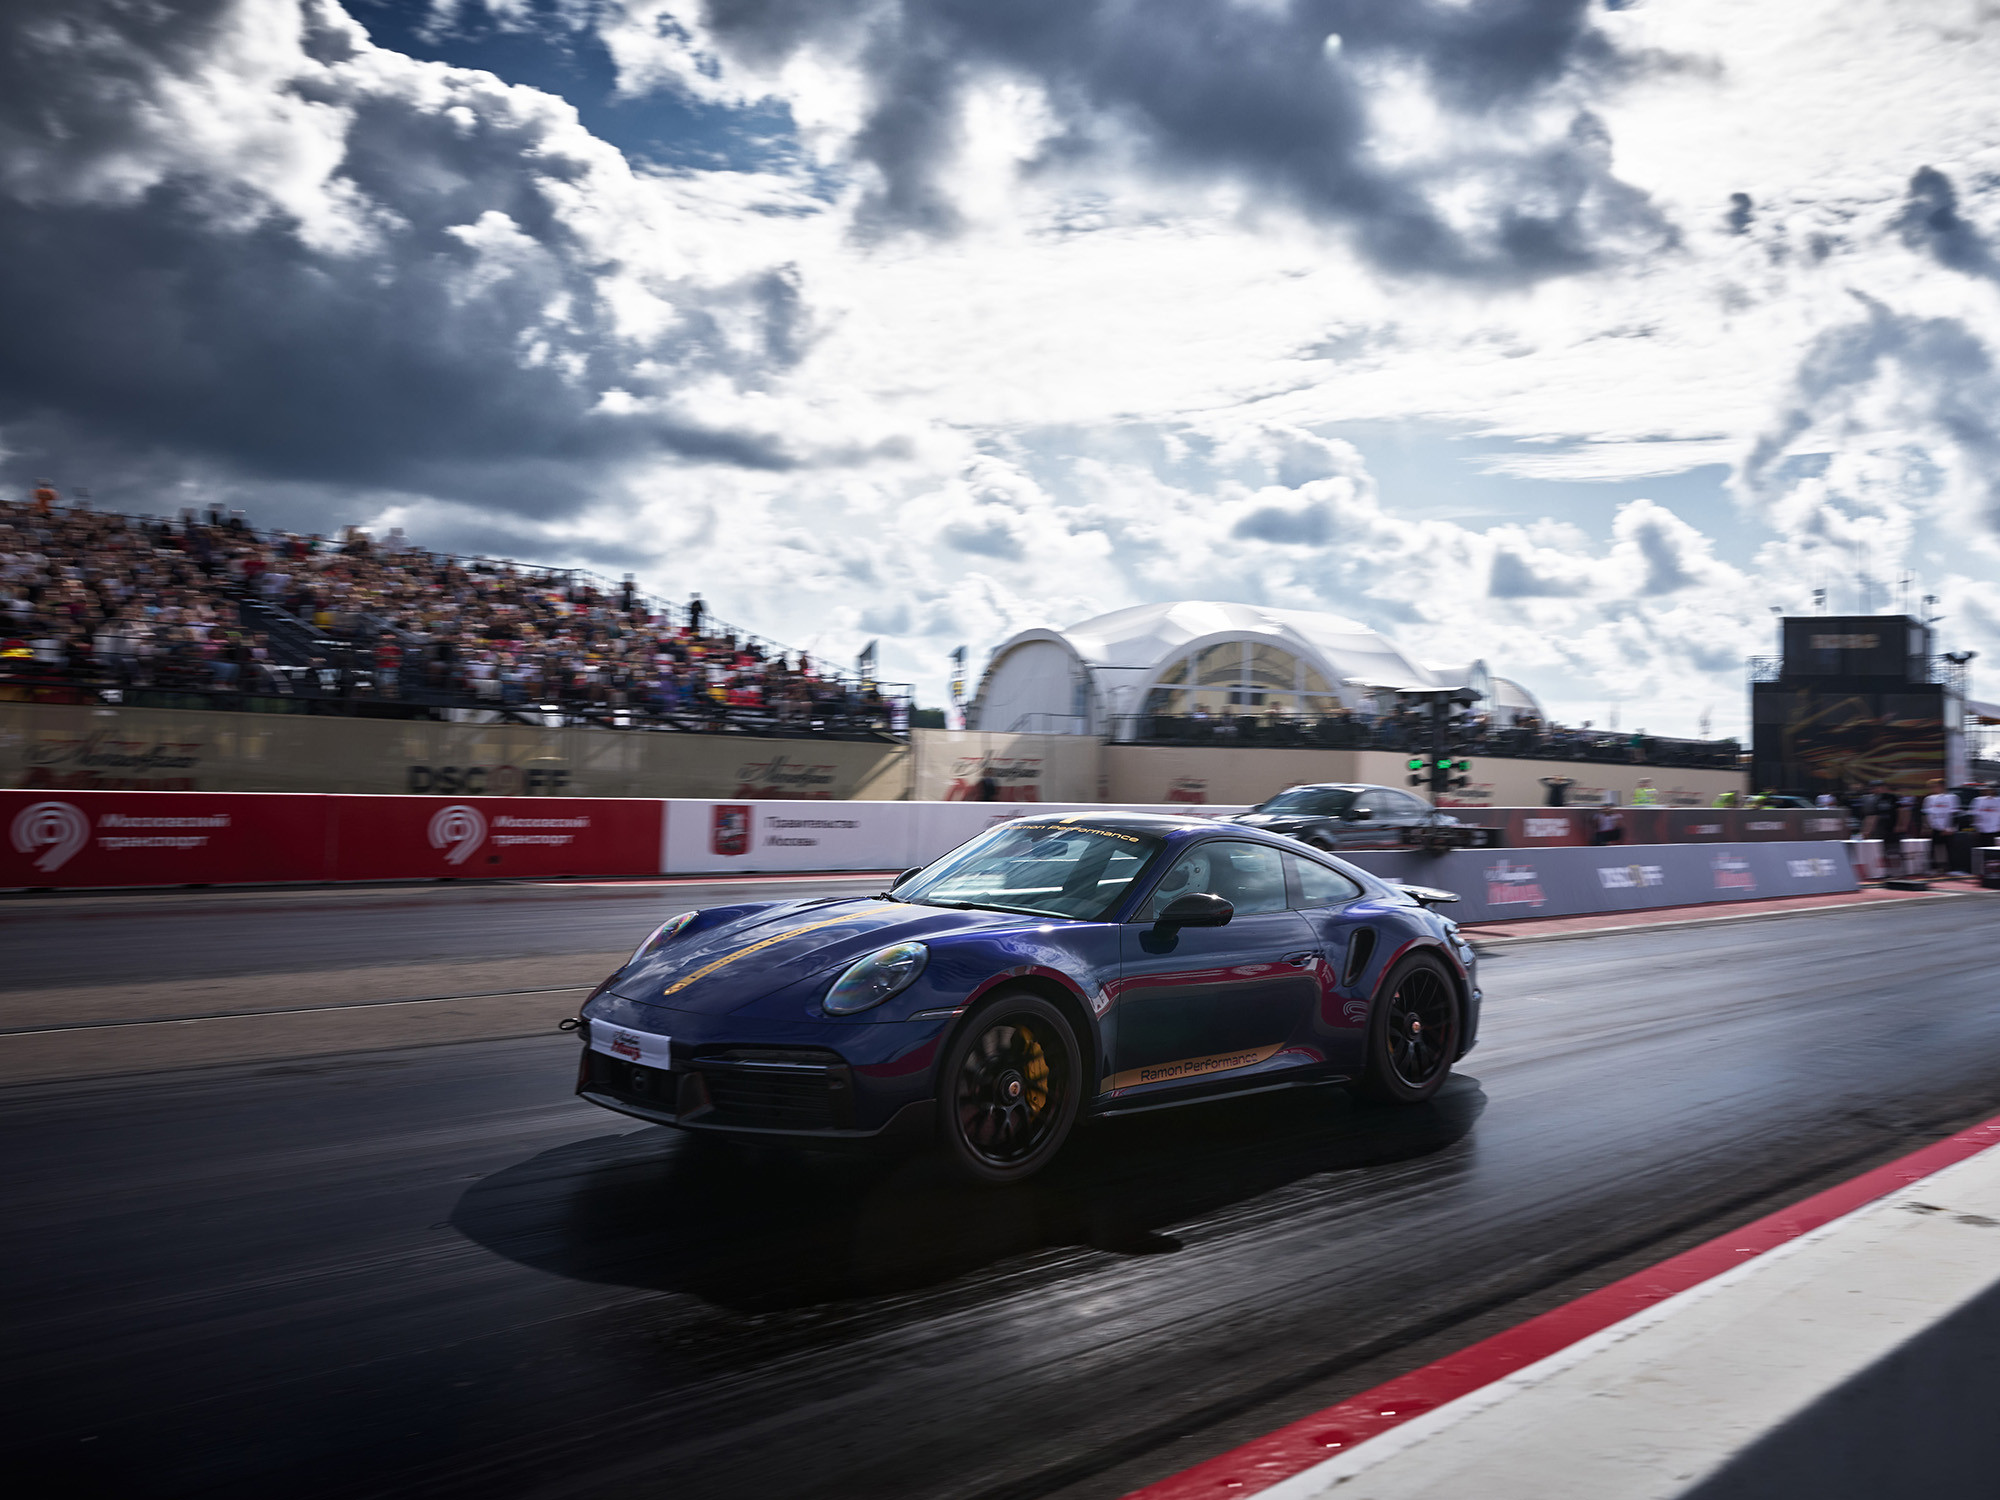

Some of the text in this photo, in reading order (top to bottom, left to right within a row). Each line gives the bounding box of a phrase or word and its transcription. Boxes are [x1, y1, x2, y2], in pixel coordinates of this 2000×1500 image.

[1047, 825, 1140, 843] Performance
[1140, 1053, 1258, 1082] Ramon Performance
